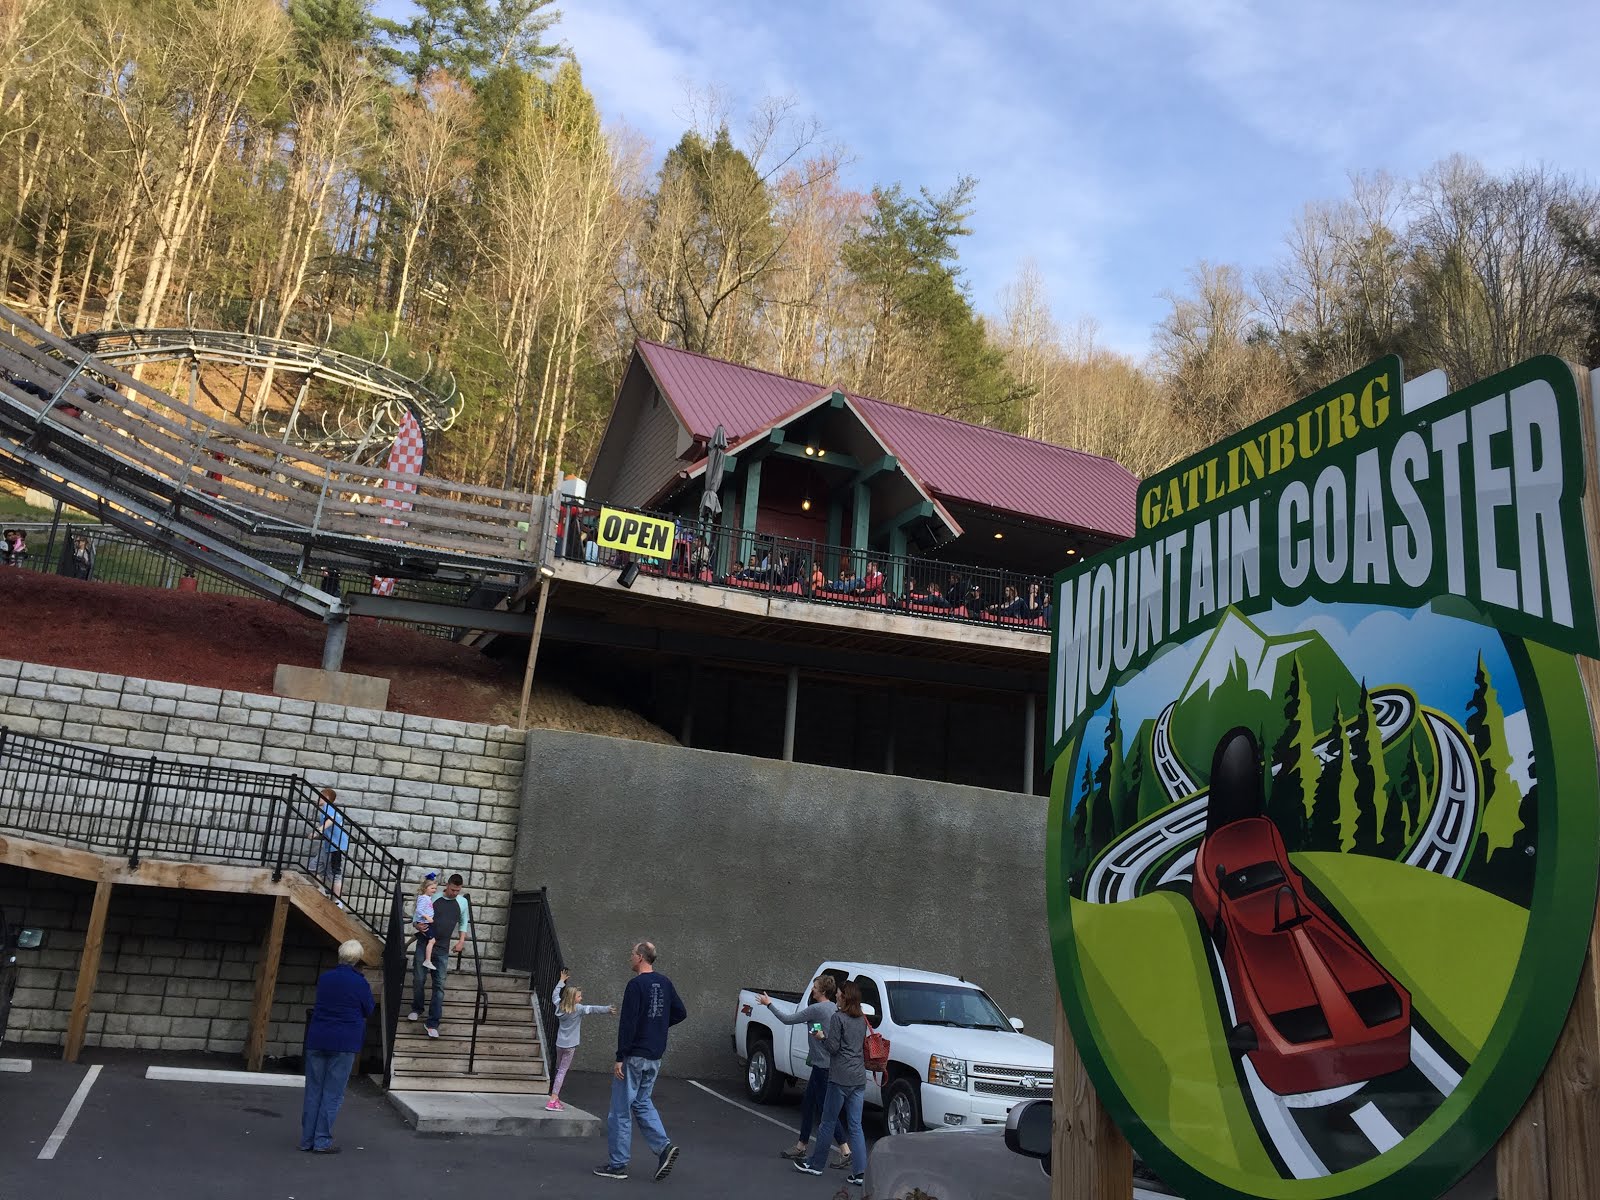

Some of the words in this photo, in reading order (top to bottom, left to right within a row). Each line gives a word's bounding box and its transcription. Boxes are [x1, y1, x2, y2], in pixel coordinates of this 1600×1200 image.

[1141, 373, 1392, 529] GATLINBURG
[602, 515, 669, 552] OPEN
[1053, 498, 1261, 747] MOUNTAIN
[1277, 378, 1575, 629] COASTER
